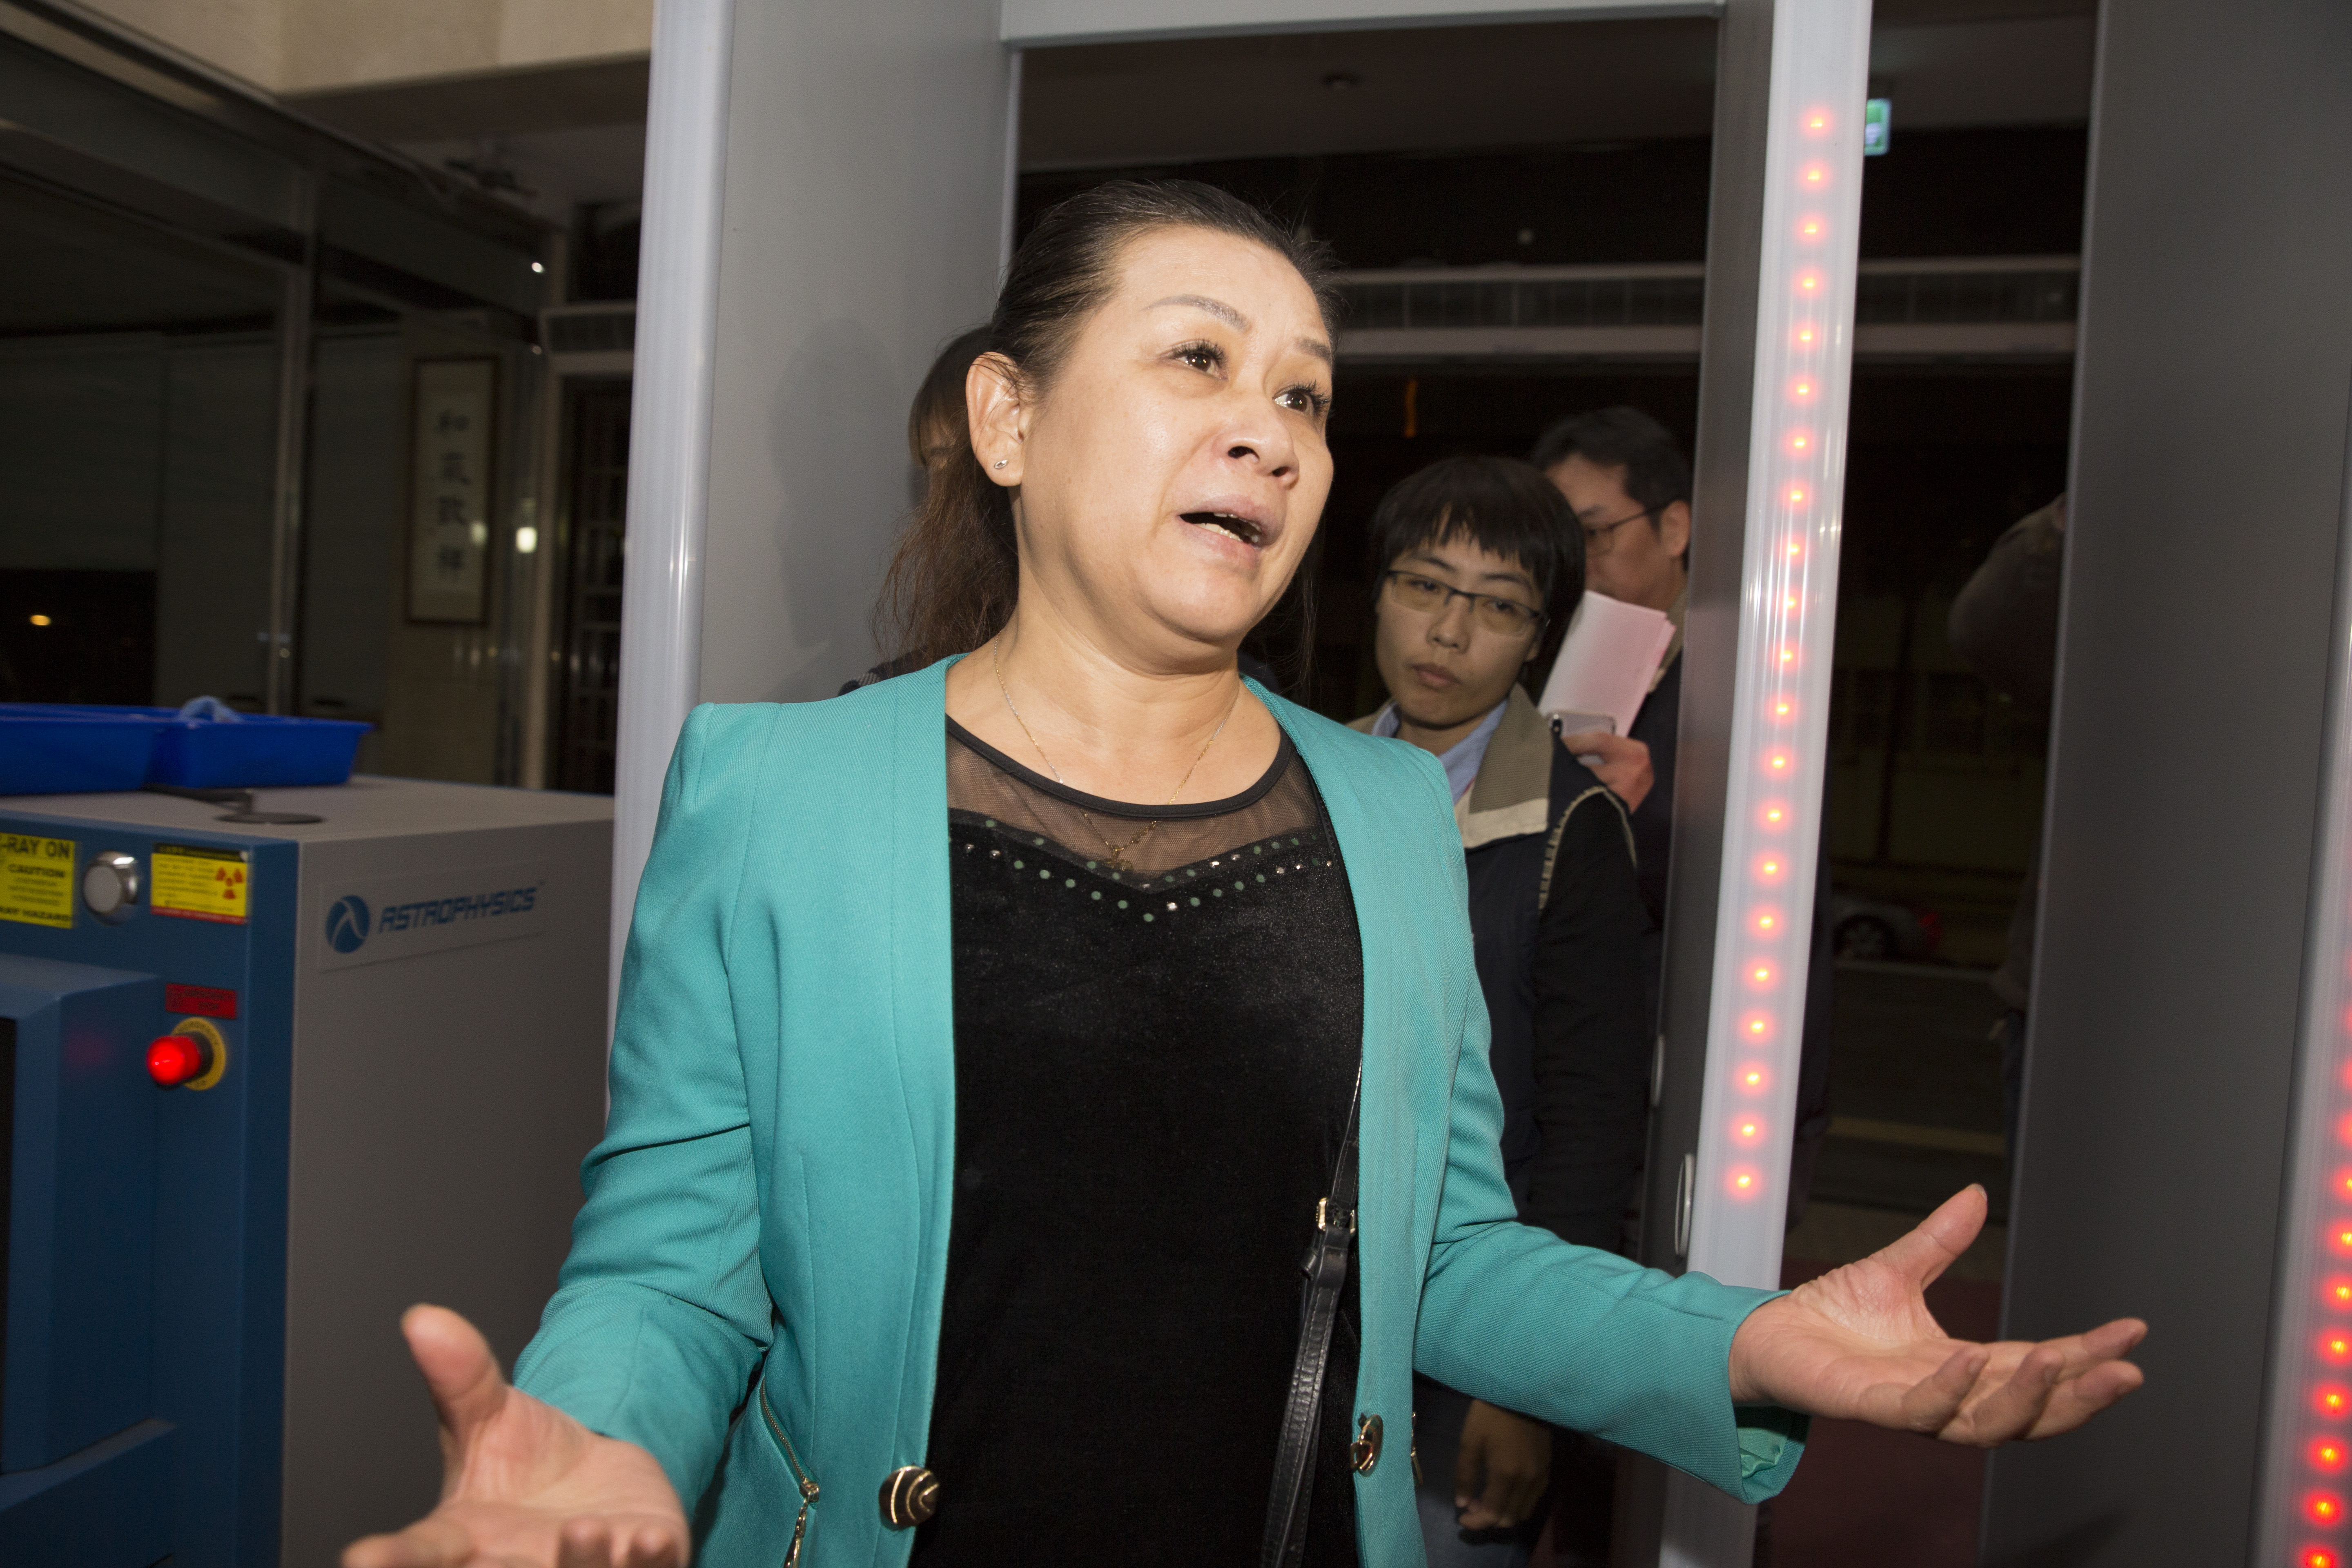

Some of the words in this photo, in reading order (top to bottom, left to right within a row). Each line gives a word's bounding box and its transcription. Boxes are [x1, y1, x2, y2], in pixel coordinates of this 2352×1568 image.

[0, 835, 40, 854] -RAY
[46, 841, 70, 858] ON
[7, 863, 65, 878] CAUTION
[378, 886, 537, 933] ASTROPHYSICS
